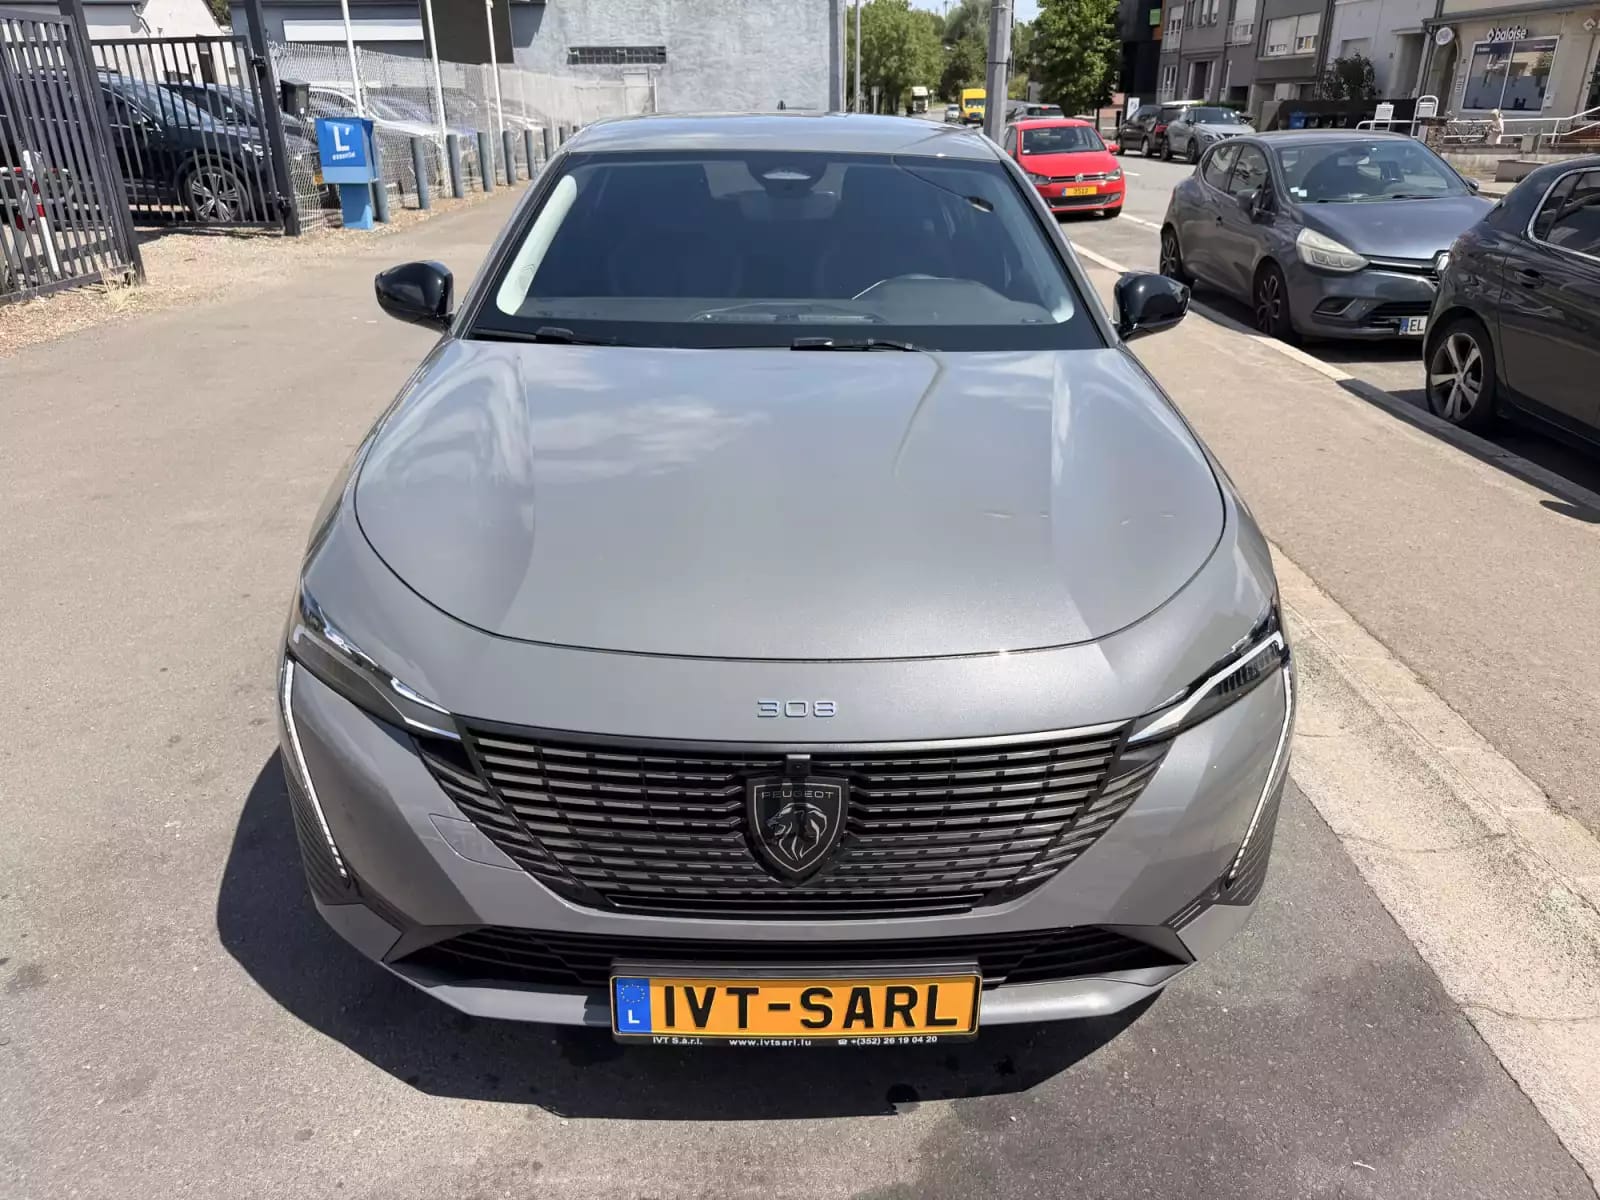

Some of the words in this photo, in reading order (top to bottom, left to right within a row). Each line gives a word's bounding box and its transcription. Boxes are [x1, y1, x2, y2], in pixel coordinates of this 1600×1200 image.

[1495, 25, 1526, 41] baloise
[333, 125, 350, 151] L'
[757, 700, 837, 718] 308
[761, 790, 834, 799] PEUGEOT
[628, 1009, 640, 1024] L
[664, 984, 958, 1029] IVT-SARL
[653, 1036, 669, 1044] IVT
[729, 1038, 811, 1047] www.ivtsarl.lu
[851, 1037, 881, 1046] +(352)
[883, 1037, 895, 1045] 26
[898, 1036, 909, 1044] 19
[912, 1036, 924, 1044] 04
